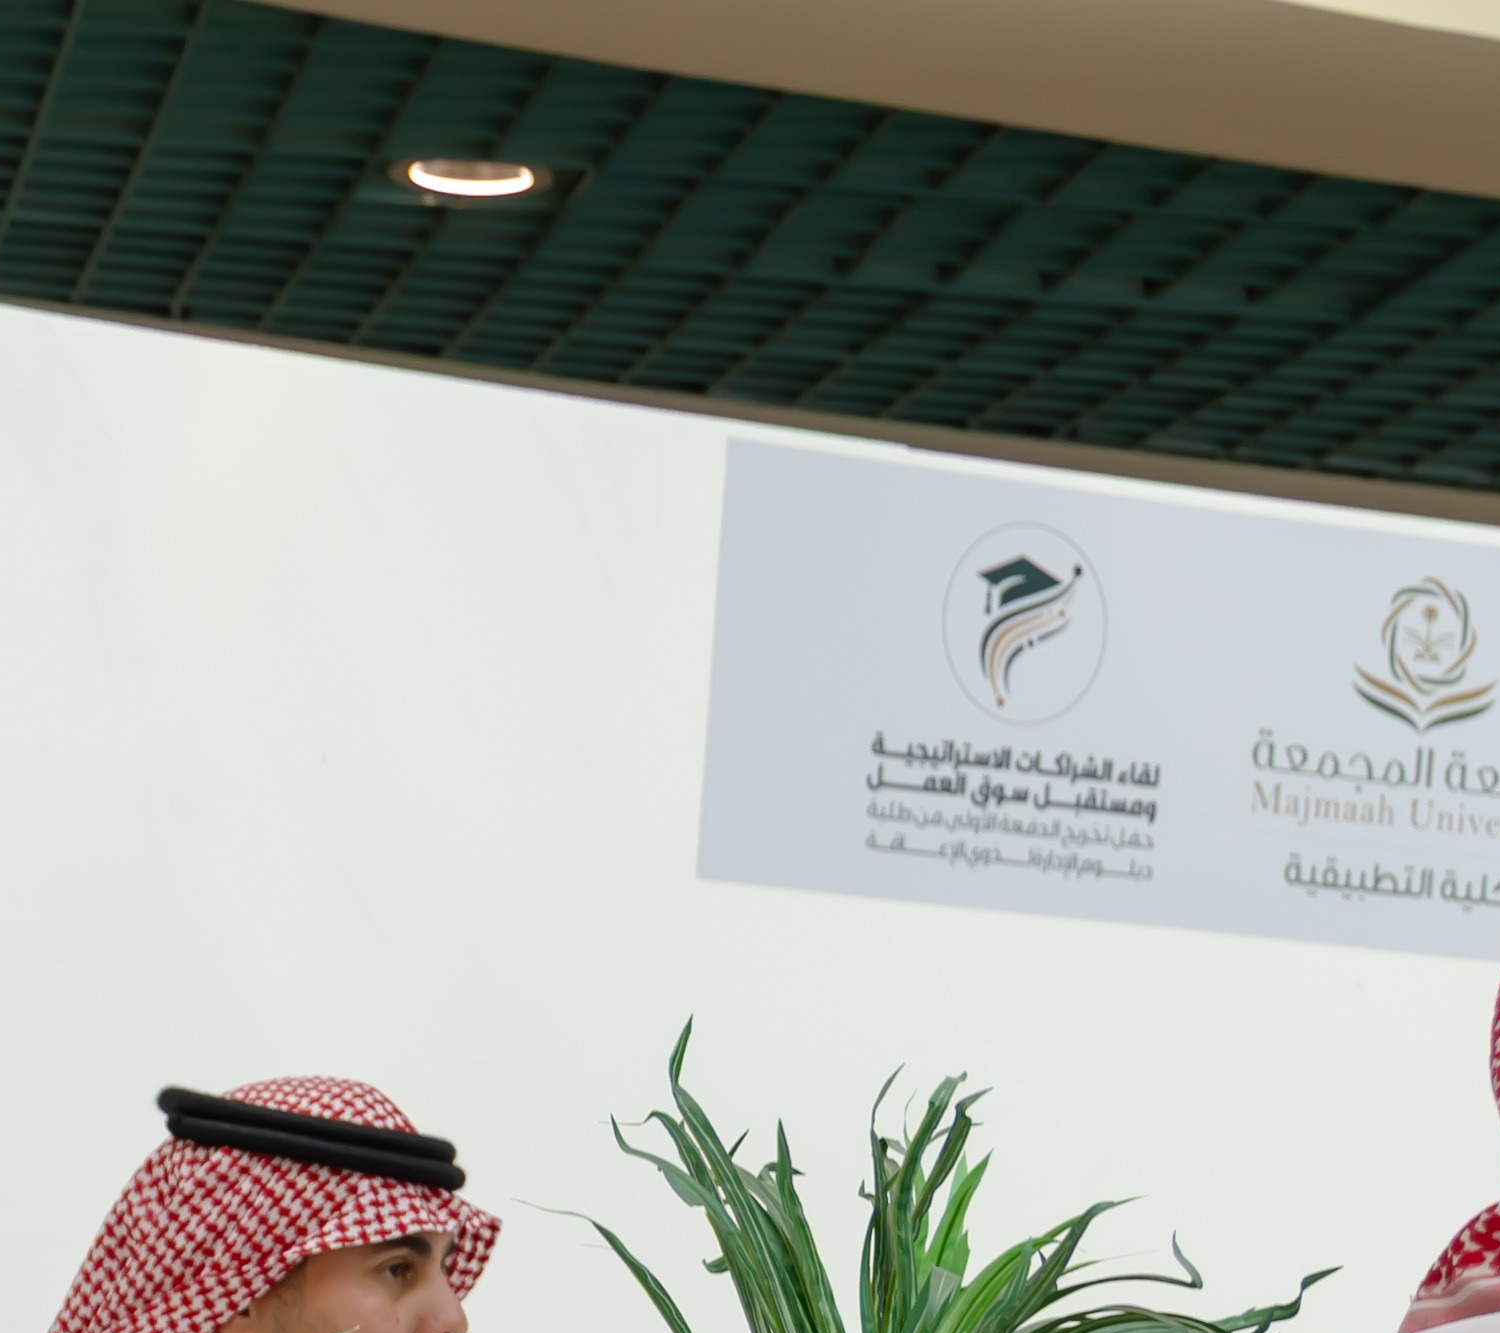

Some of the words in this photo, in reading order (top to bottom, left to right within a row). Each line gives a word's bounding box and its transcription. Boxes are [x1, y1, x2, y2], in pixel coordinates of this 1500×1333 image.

[865, 762, 967, 796] العمل
[1117, 762, 1160, 788] لقاء
[1252, 728, 1435, 794] المجمعة
[970, 774, 1029, 807] سوق
[1250, 779, 1395, 828] Majmaah
[1283, 852, 1435, 903] التطبيقية
